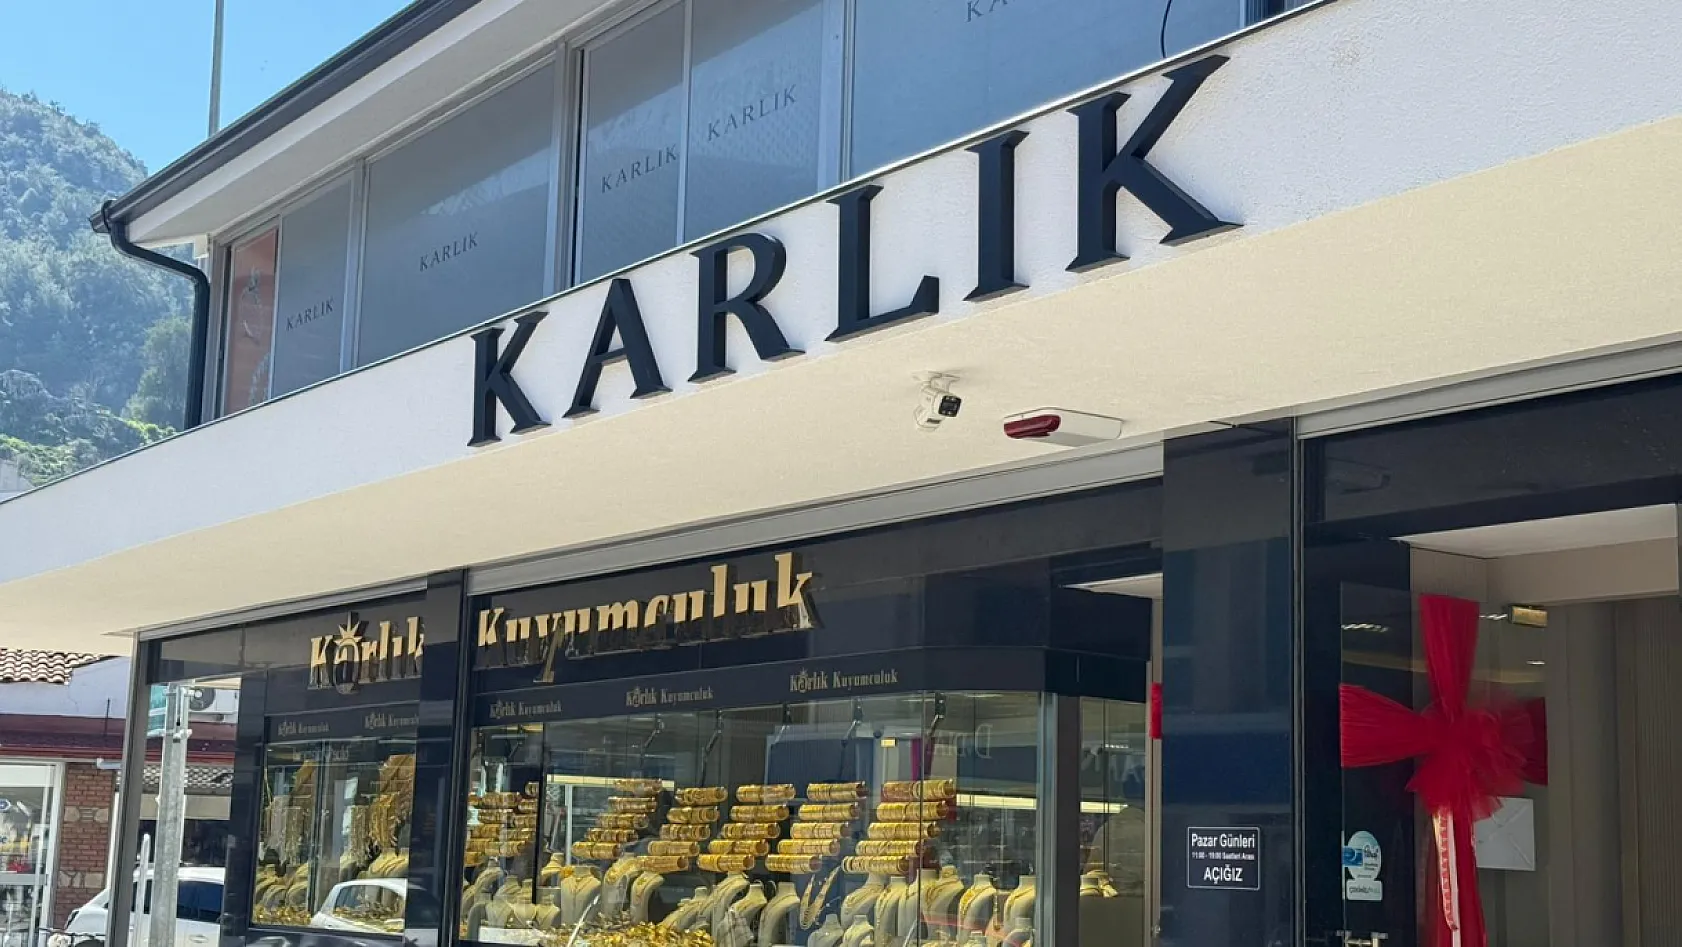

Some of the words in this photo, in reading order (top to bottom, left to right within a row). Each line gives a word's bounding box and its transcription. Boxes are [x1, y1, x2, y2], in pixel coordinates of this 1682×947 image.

[707, 84, 797, 141] KARLIK
[601, 144, 678, 194] KARLIK
[420, 232, 478, 272] KARLIK
[467, 54, 1243, 447] KARLIK
[285, 298, 335, 331] KARLIK
[472, 552, 815, 683] Kuyumculuk
[833, 669, 898, 690] Kuyumculuk
[1191, 833, 1218, 847] Pazar
[1220, 833, 1255, 848] Günleri
[1203, 863, 1243, 885] AÇIĞIZ
